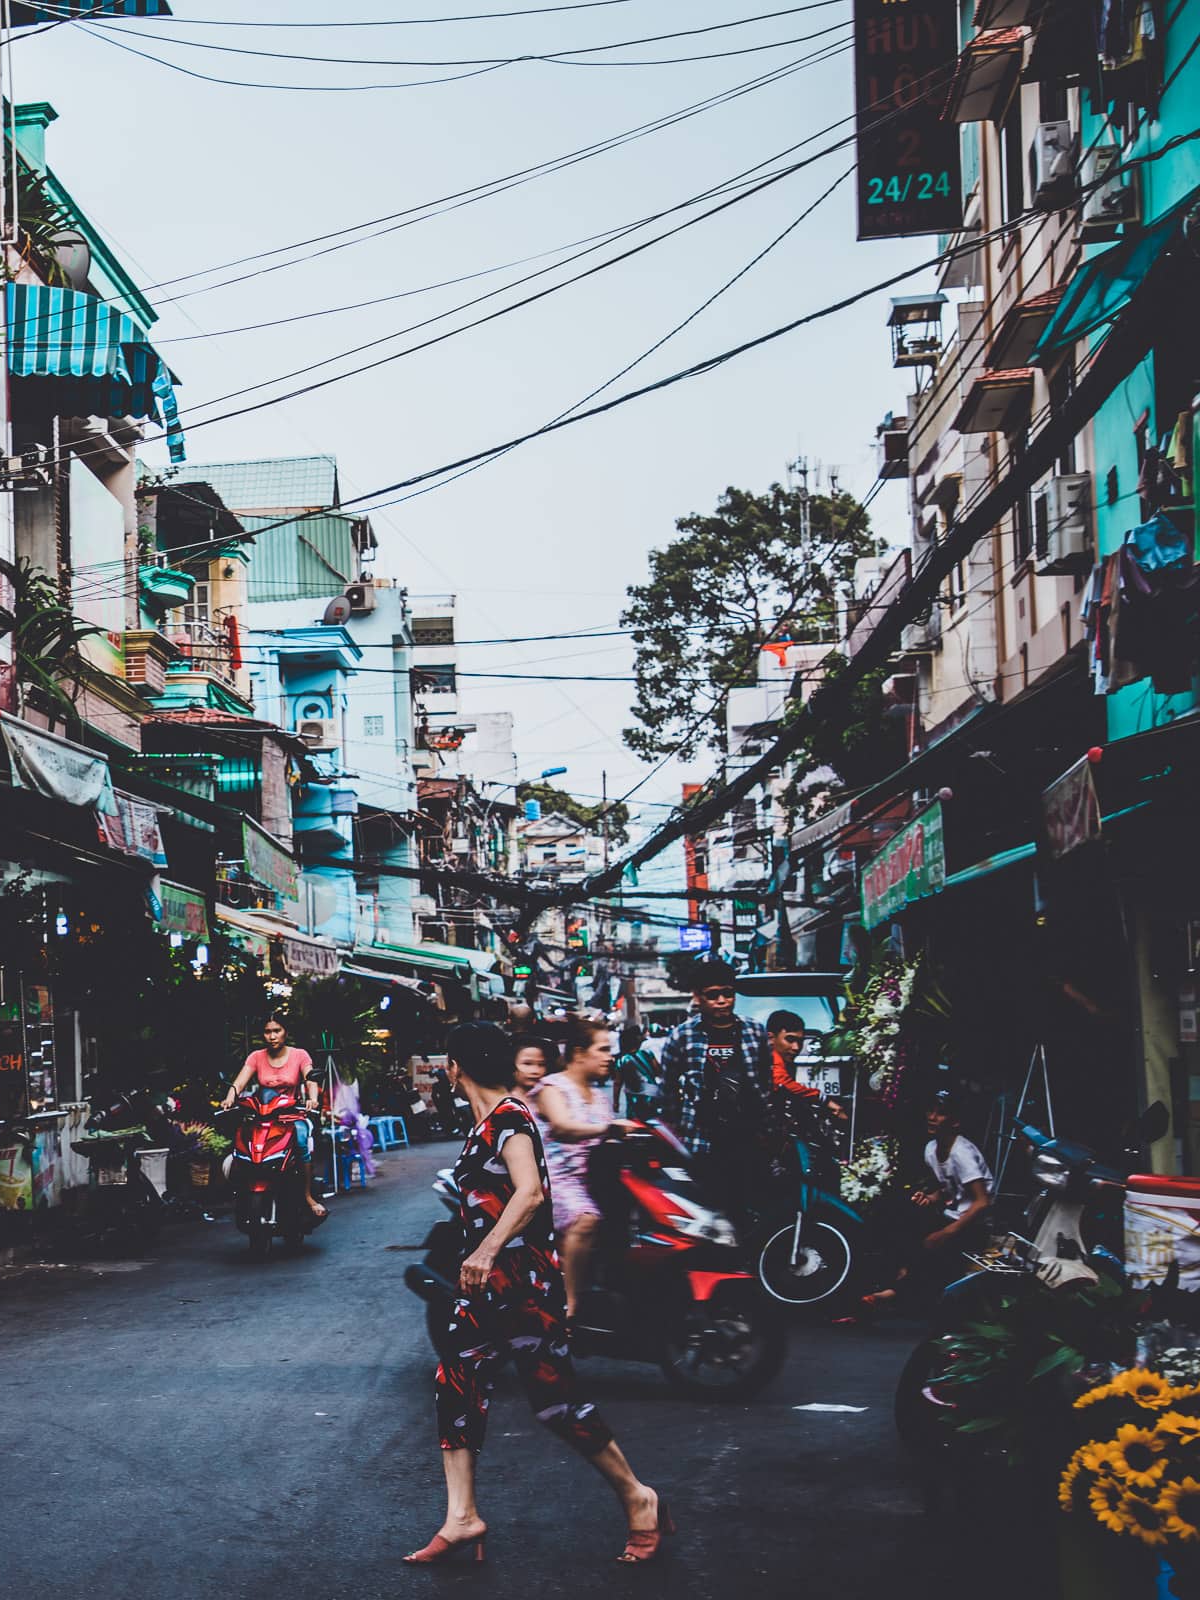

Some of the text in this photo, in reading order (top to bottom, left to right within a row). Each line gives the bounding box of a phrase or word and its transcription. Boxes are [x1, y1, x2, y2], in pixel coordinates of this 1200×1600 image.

[867, 15, 942, 54] HUY
[898, 129, 921, 167] 2
[867, 171, 950, 205] 24/24
